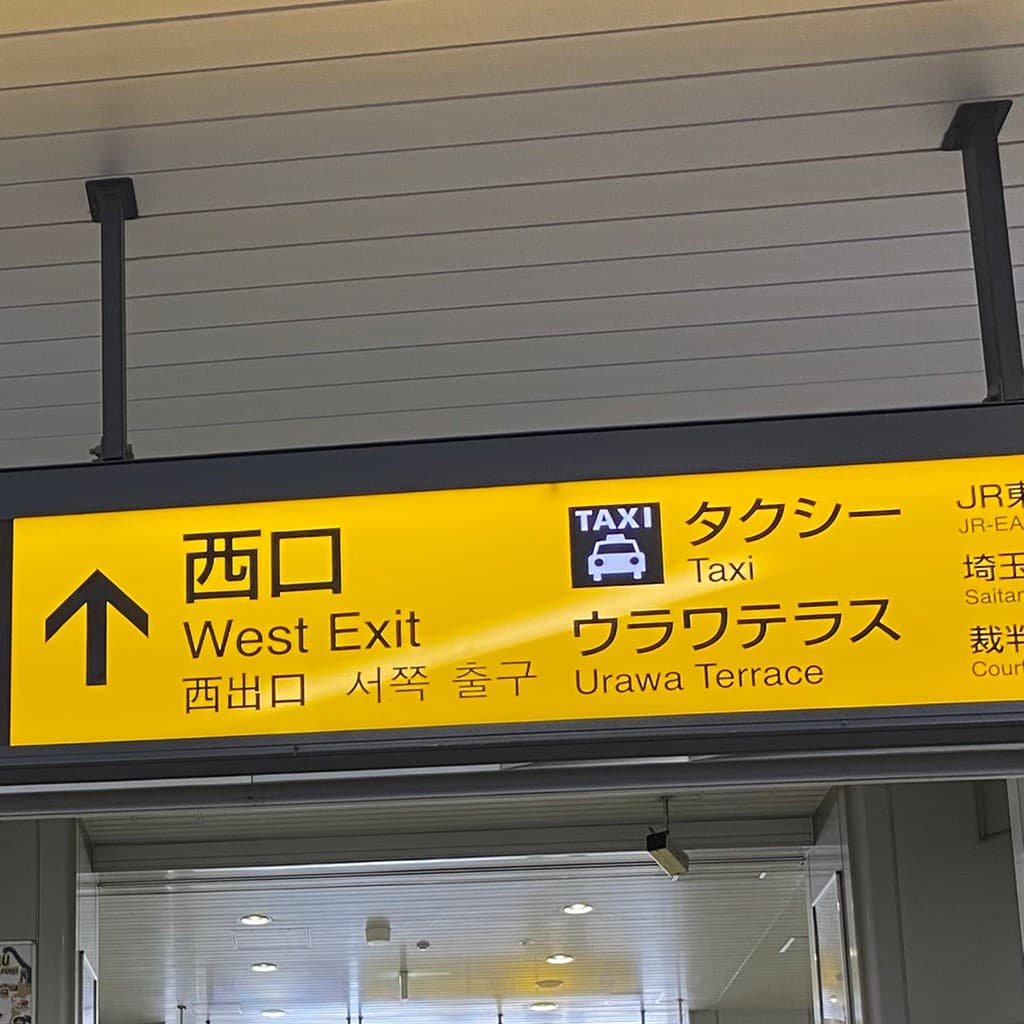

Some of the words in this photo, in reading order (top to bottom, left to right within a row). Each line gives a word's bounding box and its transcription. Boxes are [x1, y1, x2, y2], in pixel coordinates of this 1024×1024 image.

[575, 507, 652, 532] TAXI
[685, 497, 901, 547] タクシー
[183, 527, 342, 604] 西口
[687, 555, 755, 584] Taxi
[183, 617, 309, 660] West
[329, 609, 421, 652] Exit
[573, 599, 902, 657] ウラワテラス
[182, 672, 306, 715] 西出口
[345, 664, 431, 705] 서쪽
[451, 659, 538, 700] 출구
[575, 668, 684, 695] Urawa
[694, 663, 824, 690] Terrace
